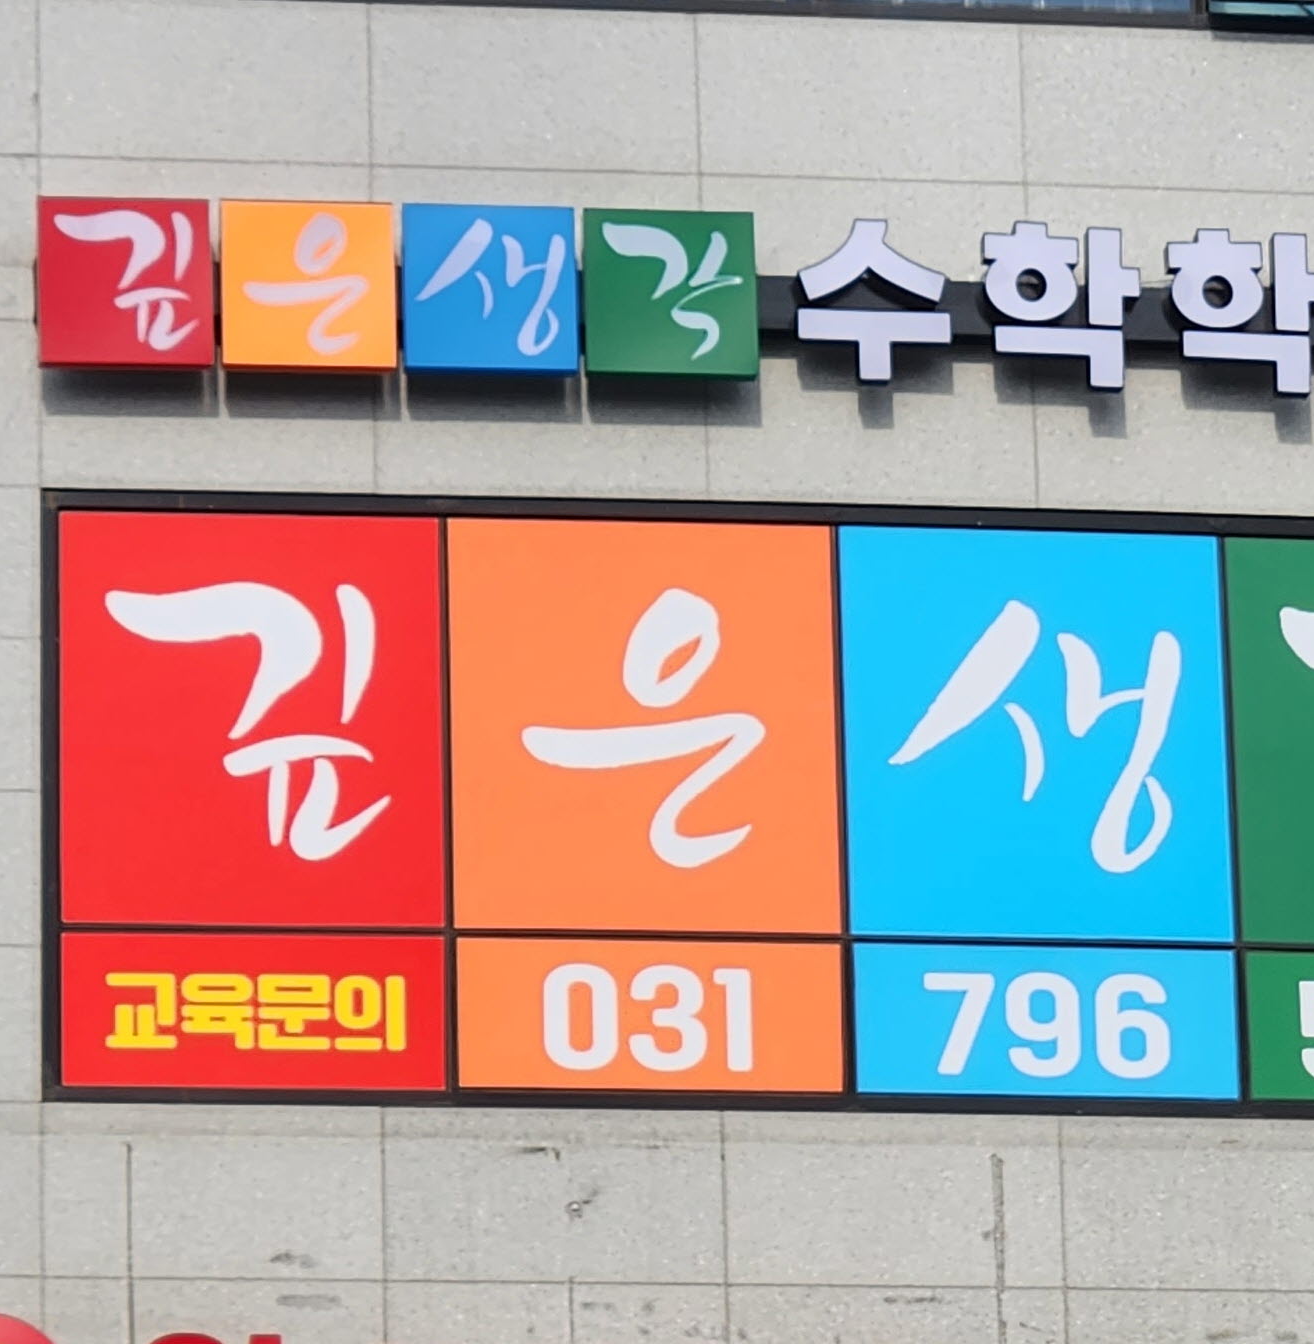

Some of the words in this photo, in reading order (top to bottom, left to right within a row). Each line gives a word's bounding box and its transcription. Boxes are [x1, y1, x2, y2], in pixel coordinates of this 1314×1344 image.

[105, 972, 407, 1052] 교육문의
[543, 963, 754, 1073] 031
[922, 972, 1171, 1080] 796
